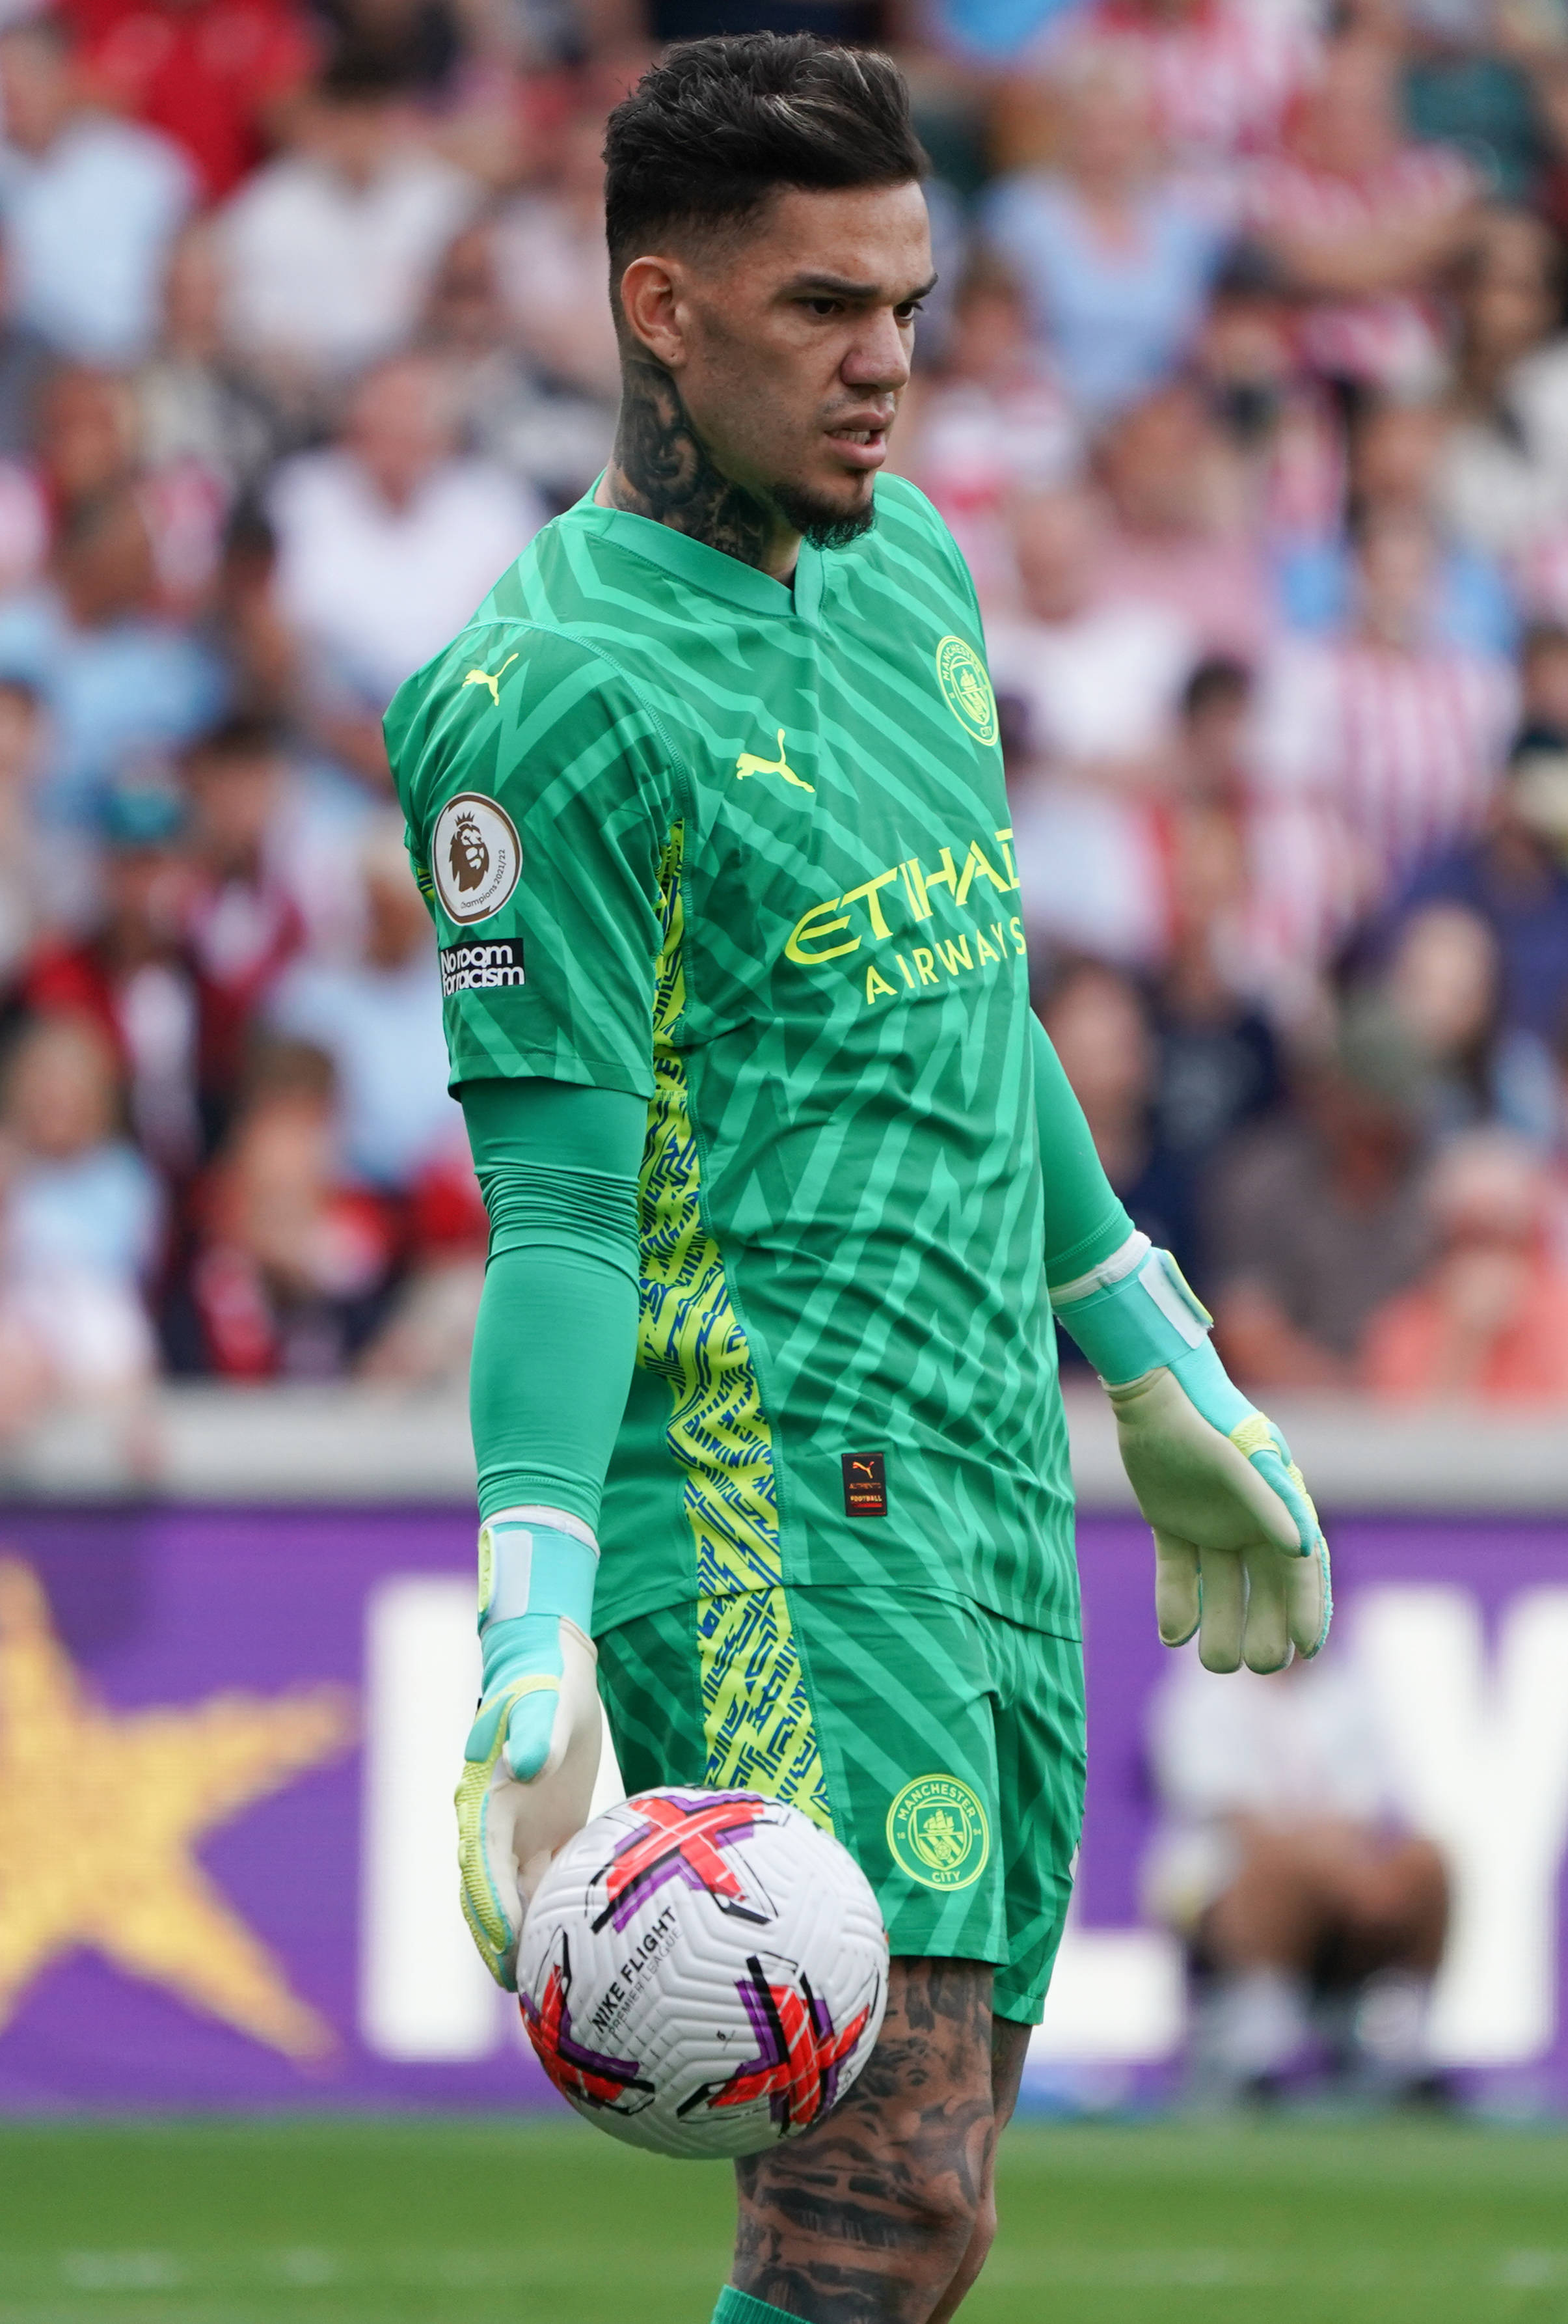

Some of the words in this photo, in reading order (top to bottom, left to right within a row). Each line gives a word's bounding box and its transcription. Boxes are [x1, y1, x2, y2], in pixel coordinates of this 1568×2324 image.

[494, 849, 506, 884] 2021/22
[440, 950, 456, 974] No
[457, 945, 513, 968] room
[867, 917, 1027, 1005] AIRWAYS
[455, 966, 524, 991] racism
[897, 1784, 976, 1821] MANCHESTER
[932, 1871, 960, 1882] CITY
[591, 1982, 625, 2033] NIKE
[621, 1906, 676, 1984] FLIGHT
[608, 1982, 645, 2036] PREMIER
[641, 1928, 682, 1982] LEAGUE
